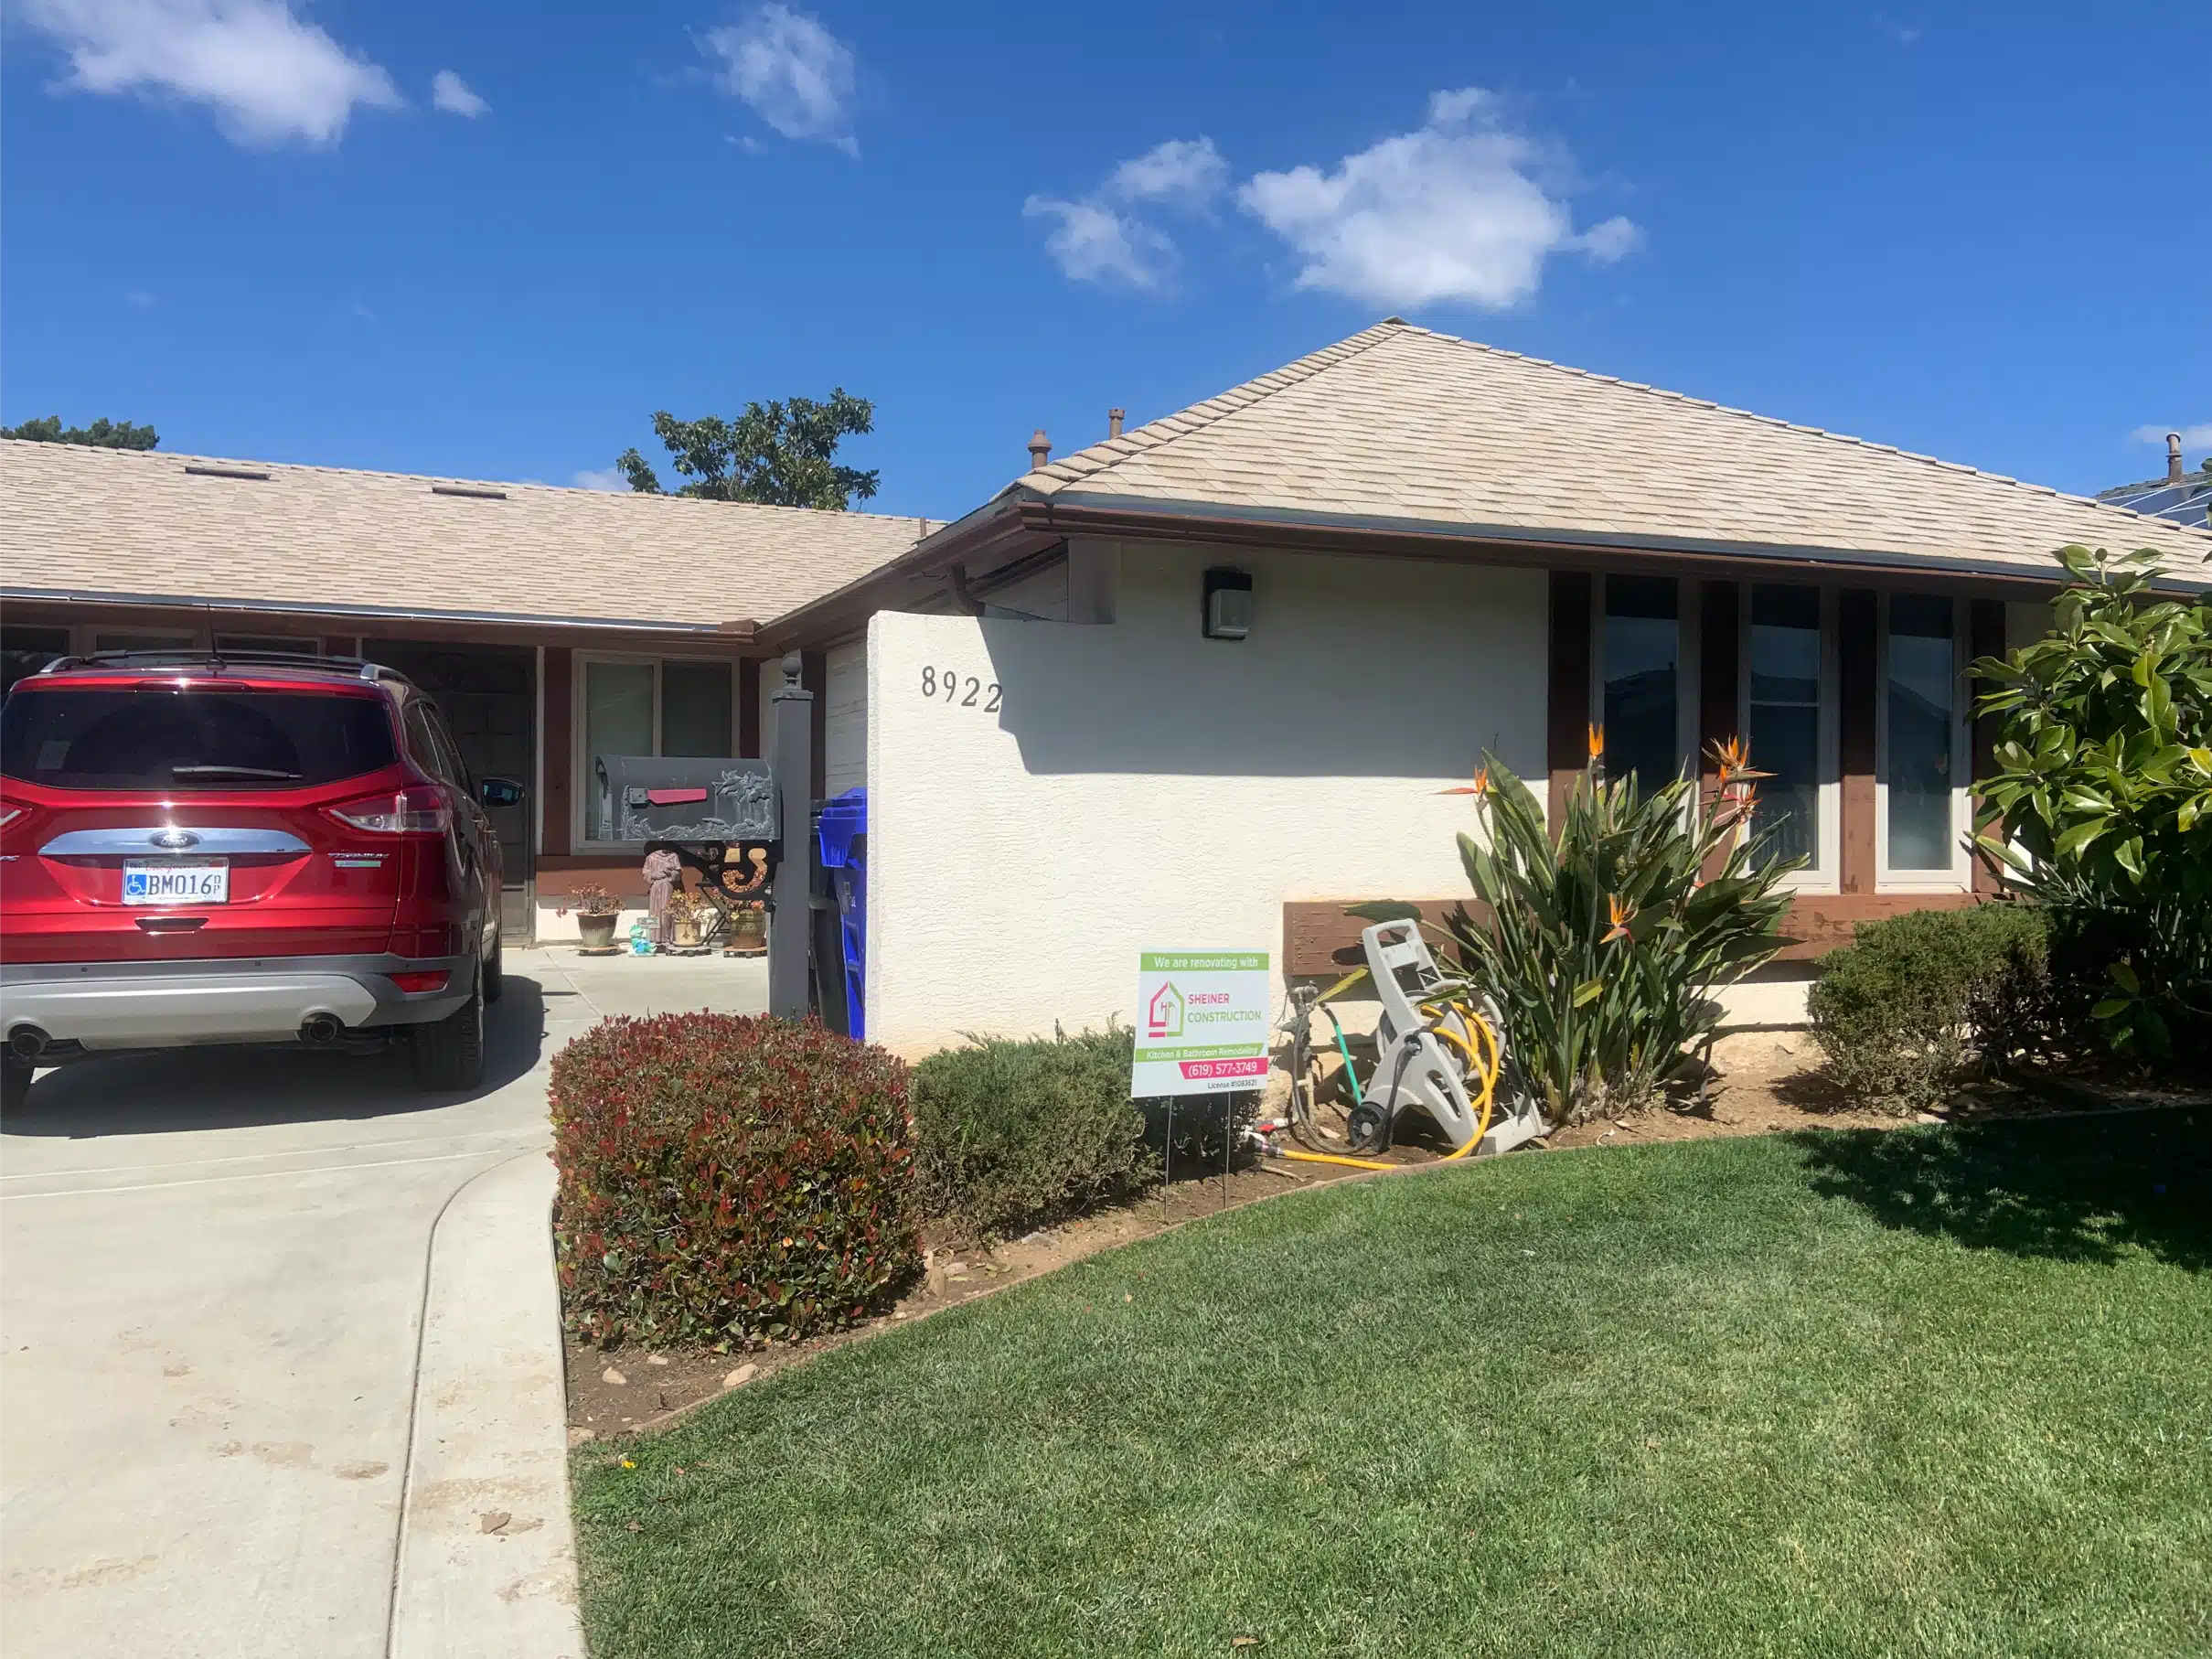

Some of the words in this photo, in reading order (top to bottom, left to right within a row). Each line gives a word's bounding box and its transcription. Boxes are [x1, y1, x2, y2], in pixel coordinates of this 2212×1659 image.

[922, 665, 1003, 712] 8922
[147, 874, 212, 894] BM016
[1153, 956, 1170, 968] We
[1172, 958, 1188, 968] are
[1191, 957, 1237, 969] renovating
[1239, 957, 1258, 967] with
[1188, 993, 1230, 1005] SHEINER
[1188, 1011, 1262, 1022] CONSTRUCTION
[1147, 1050, 1176, 1059] Kitchen
[1182, 1048, 1218, 1058] Bathroom
[1218, 1046, 1258, 1056] Remodeling
[1189, 1064, 1213, 1077] (619)
[1215, 1061, 1257, 1076] 577-3749
